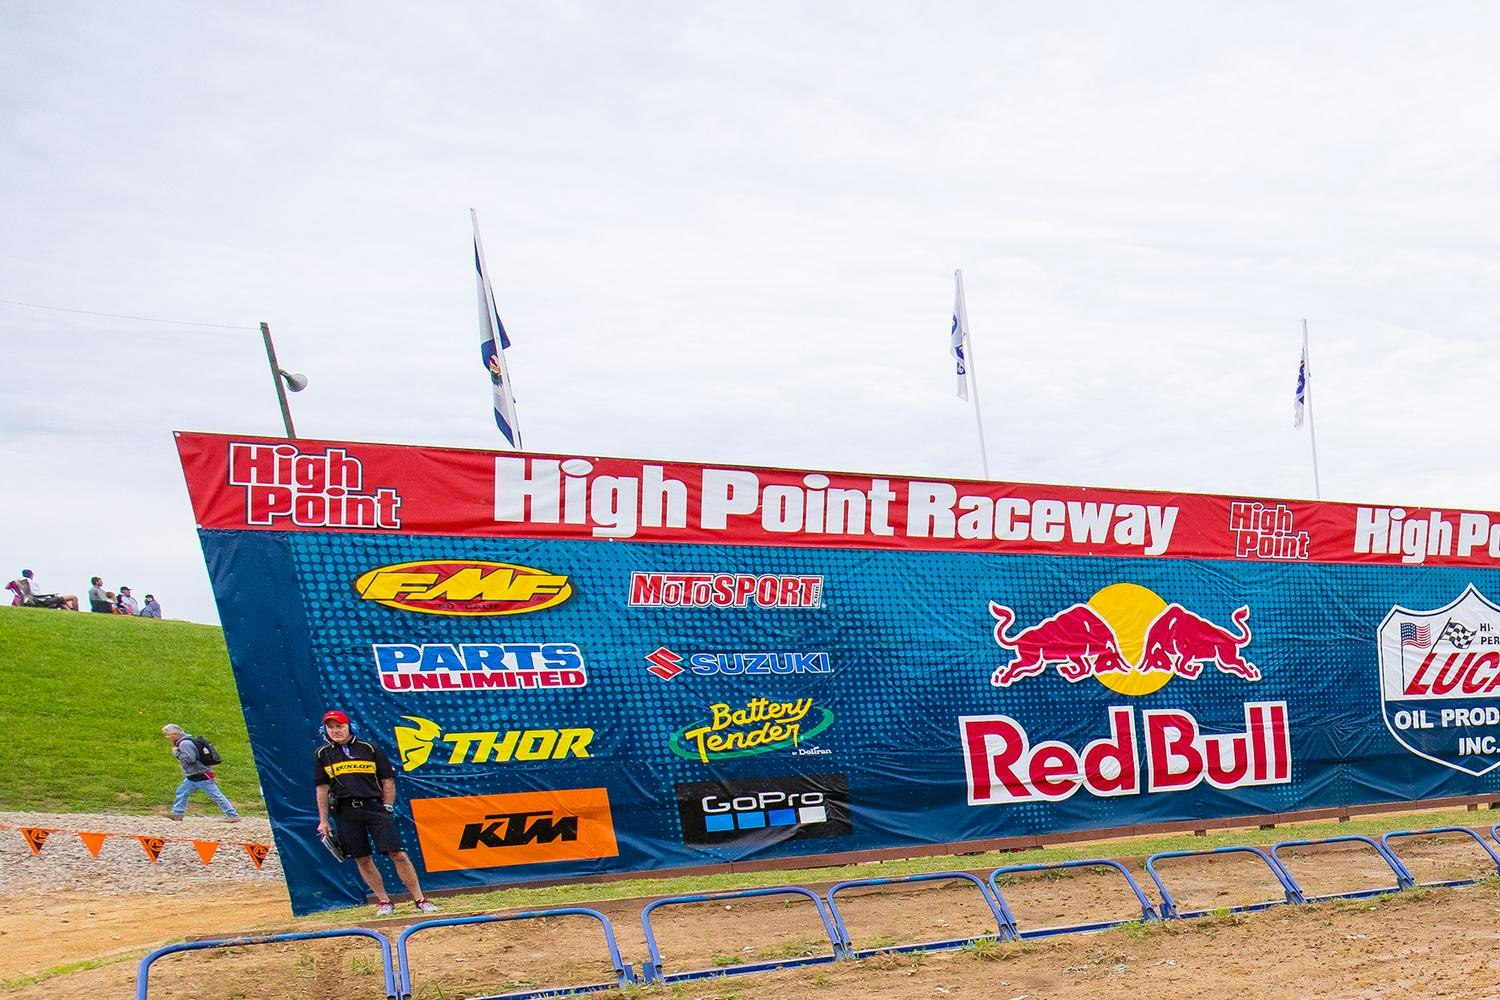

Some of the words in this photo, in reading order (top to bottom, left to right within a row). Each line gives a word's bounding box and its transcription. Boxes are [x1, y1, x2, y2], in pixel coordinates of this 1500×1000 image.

[228, 441, 363, 494] High
[247, 485, 402, 529] Point
[494, 457, 688, 538] High
[701, 468, 896, 537] Point
[907, 480, 1180, 556] Raceway
[1230, 502, 1293, 532] High
[1236, 529, 1310, 560] Point
[1354, 507, 1452, 564] High
[361, 567, 569, 601] FMF
[373, 643, 584, 673] PARTS
[690, 652, 833, 676] SUZUKI
[382, 670, 586, 692] UNLIMITED
[709, 697, 813, 731] Battery
[1394, 710, 1434, 730] OIL
[443, 727, 595, 765] THOR
[685, 721, 801, 763] Tender
[958, 705, 1140, 806] Red
[1143, 700, 1292, 793] Bull
[1458, 736, 1500, 756] INC.
[458, 810, 579, 851] KTM
